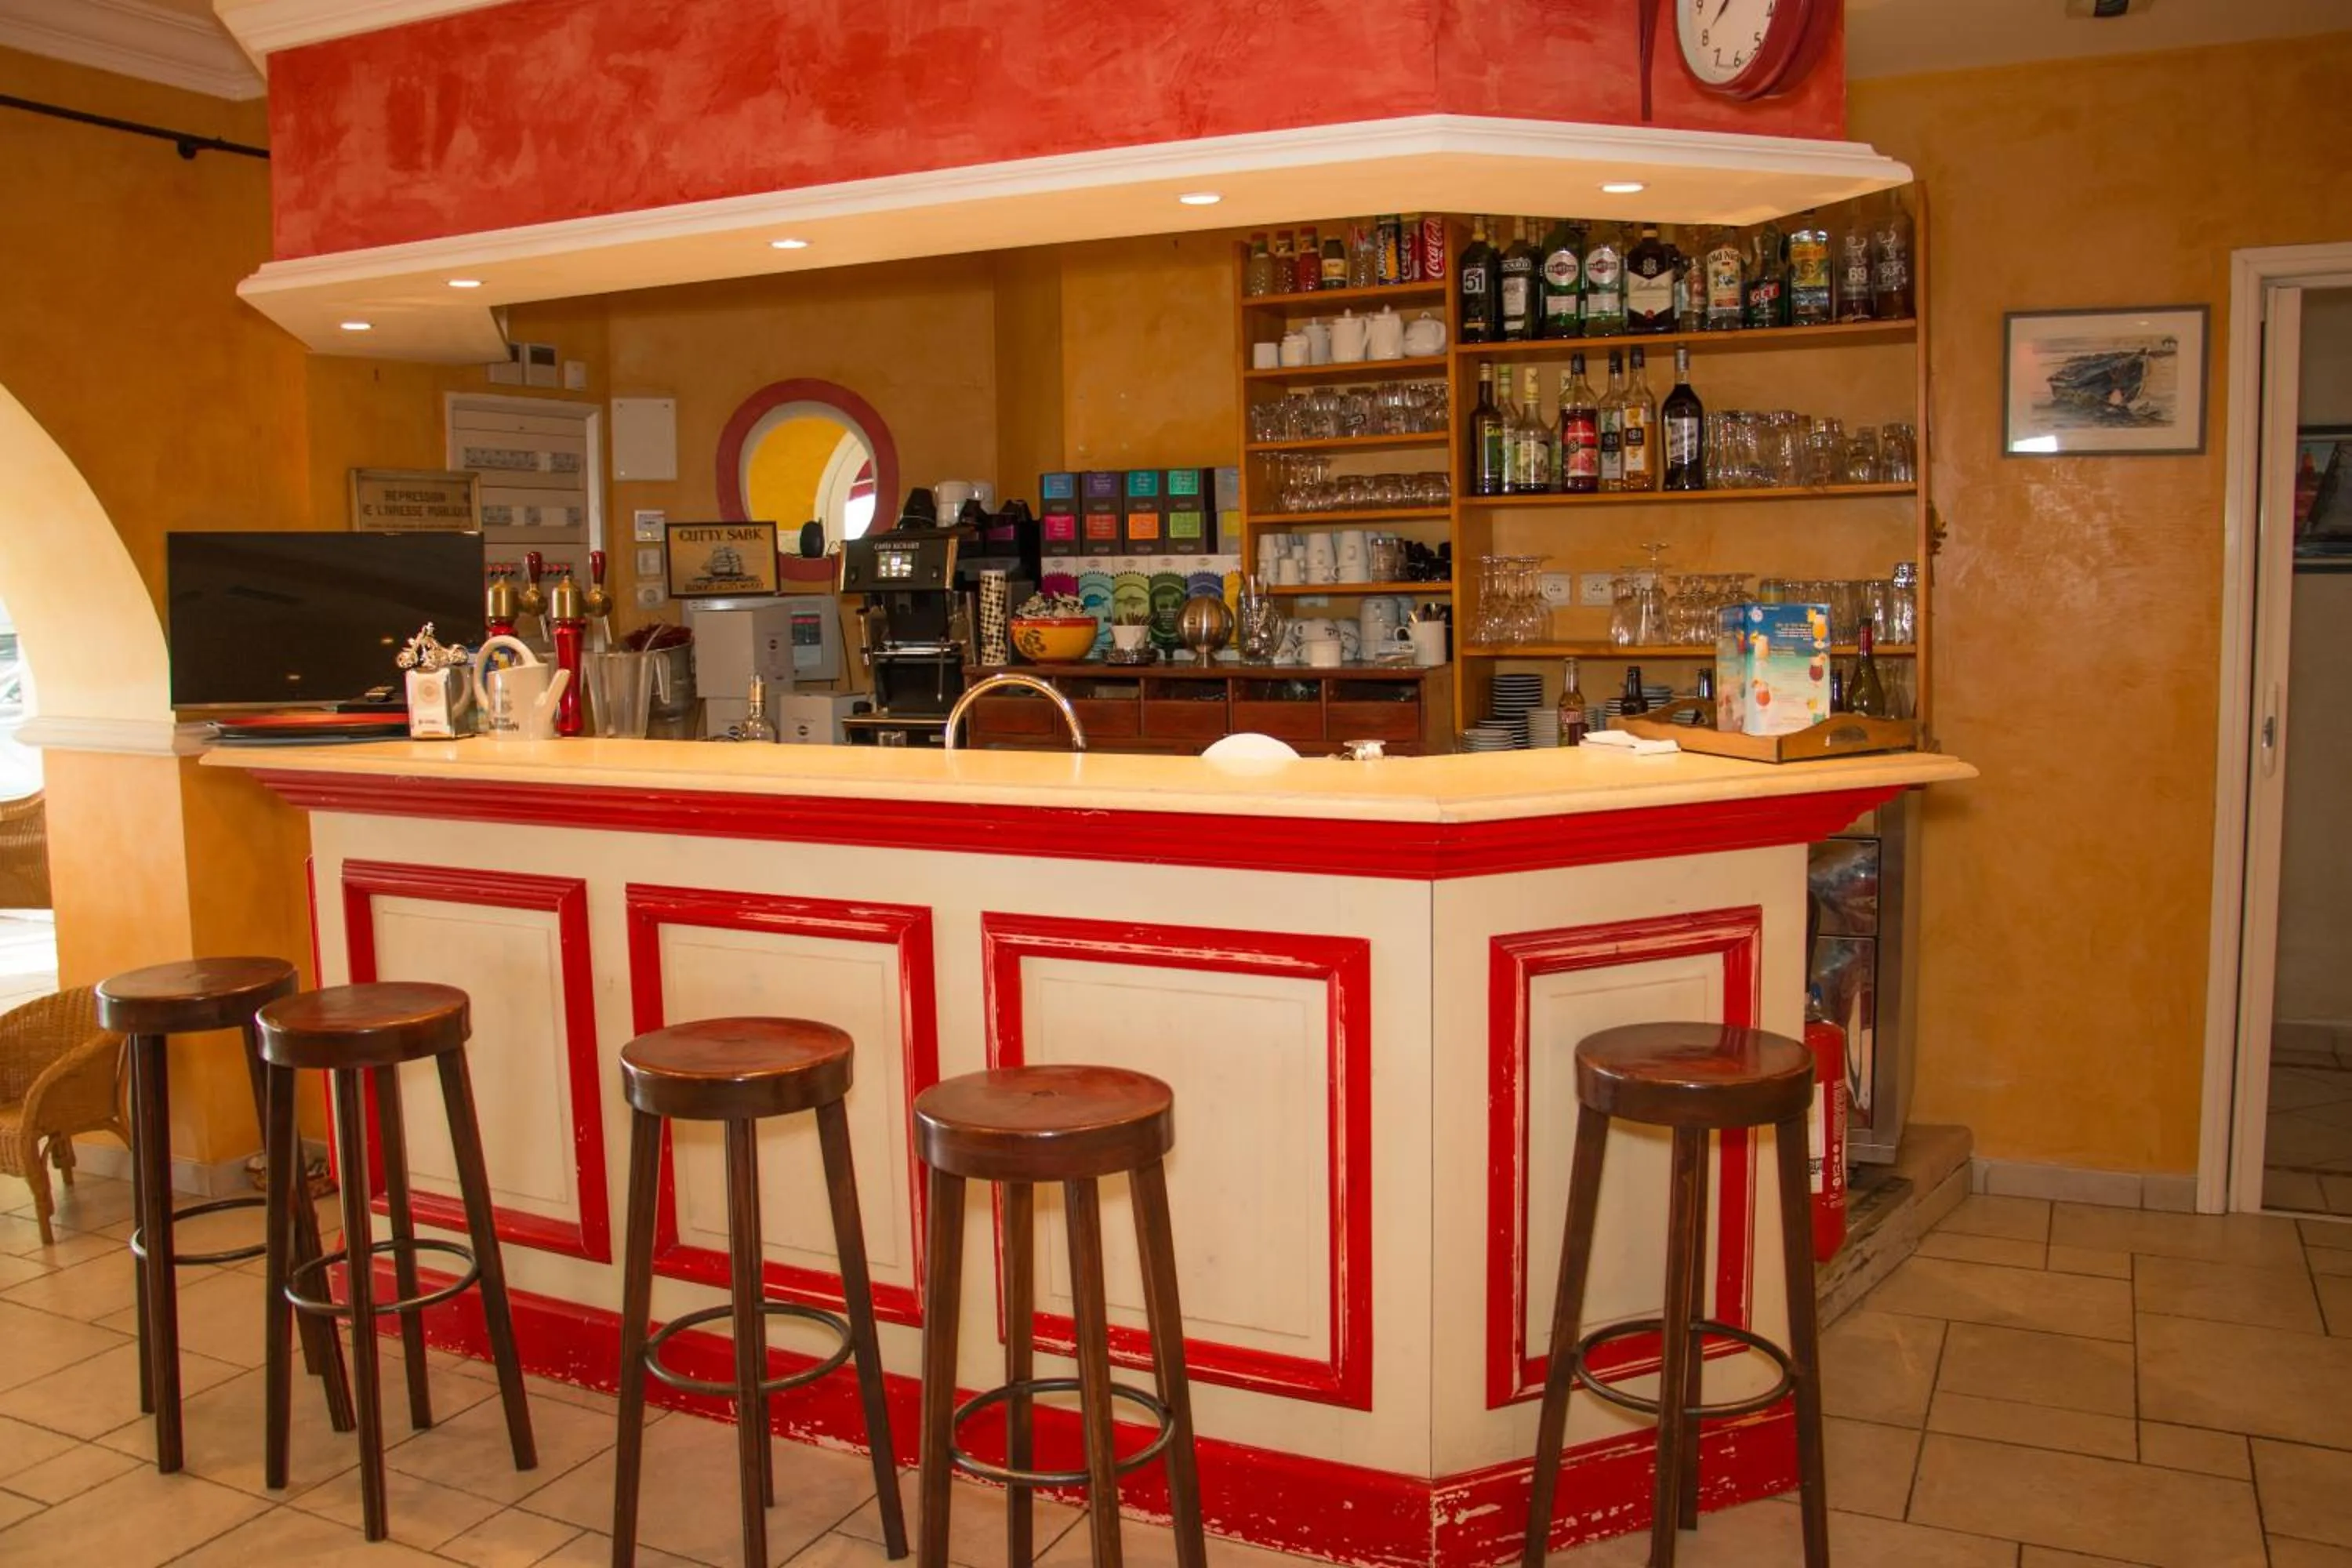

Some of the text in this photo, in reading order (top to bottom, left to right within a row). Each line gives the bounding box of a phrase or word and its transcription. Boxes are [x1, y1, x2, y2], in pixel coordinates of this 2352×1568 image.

[1701, 28, 1709, 47] 8
[1754, 31, 1762, 51] 5
[1713, 48, 1722, 67] 7
[1733, 49, 1742, 68] 6
[677, 528, 723, 543] CUTTY
